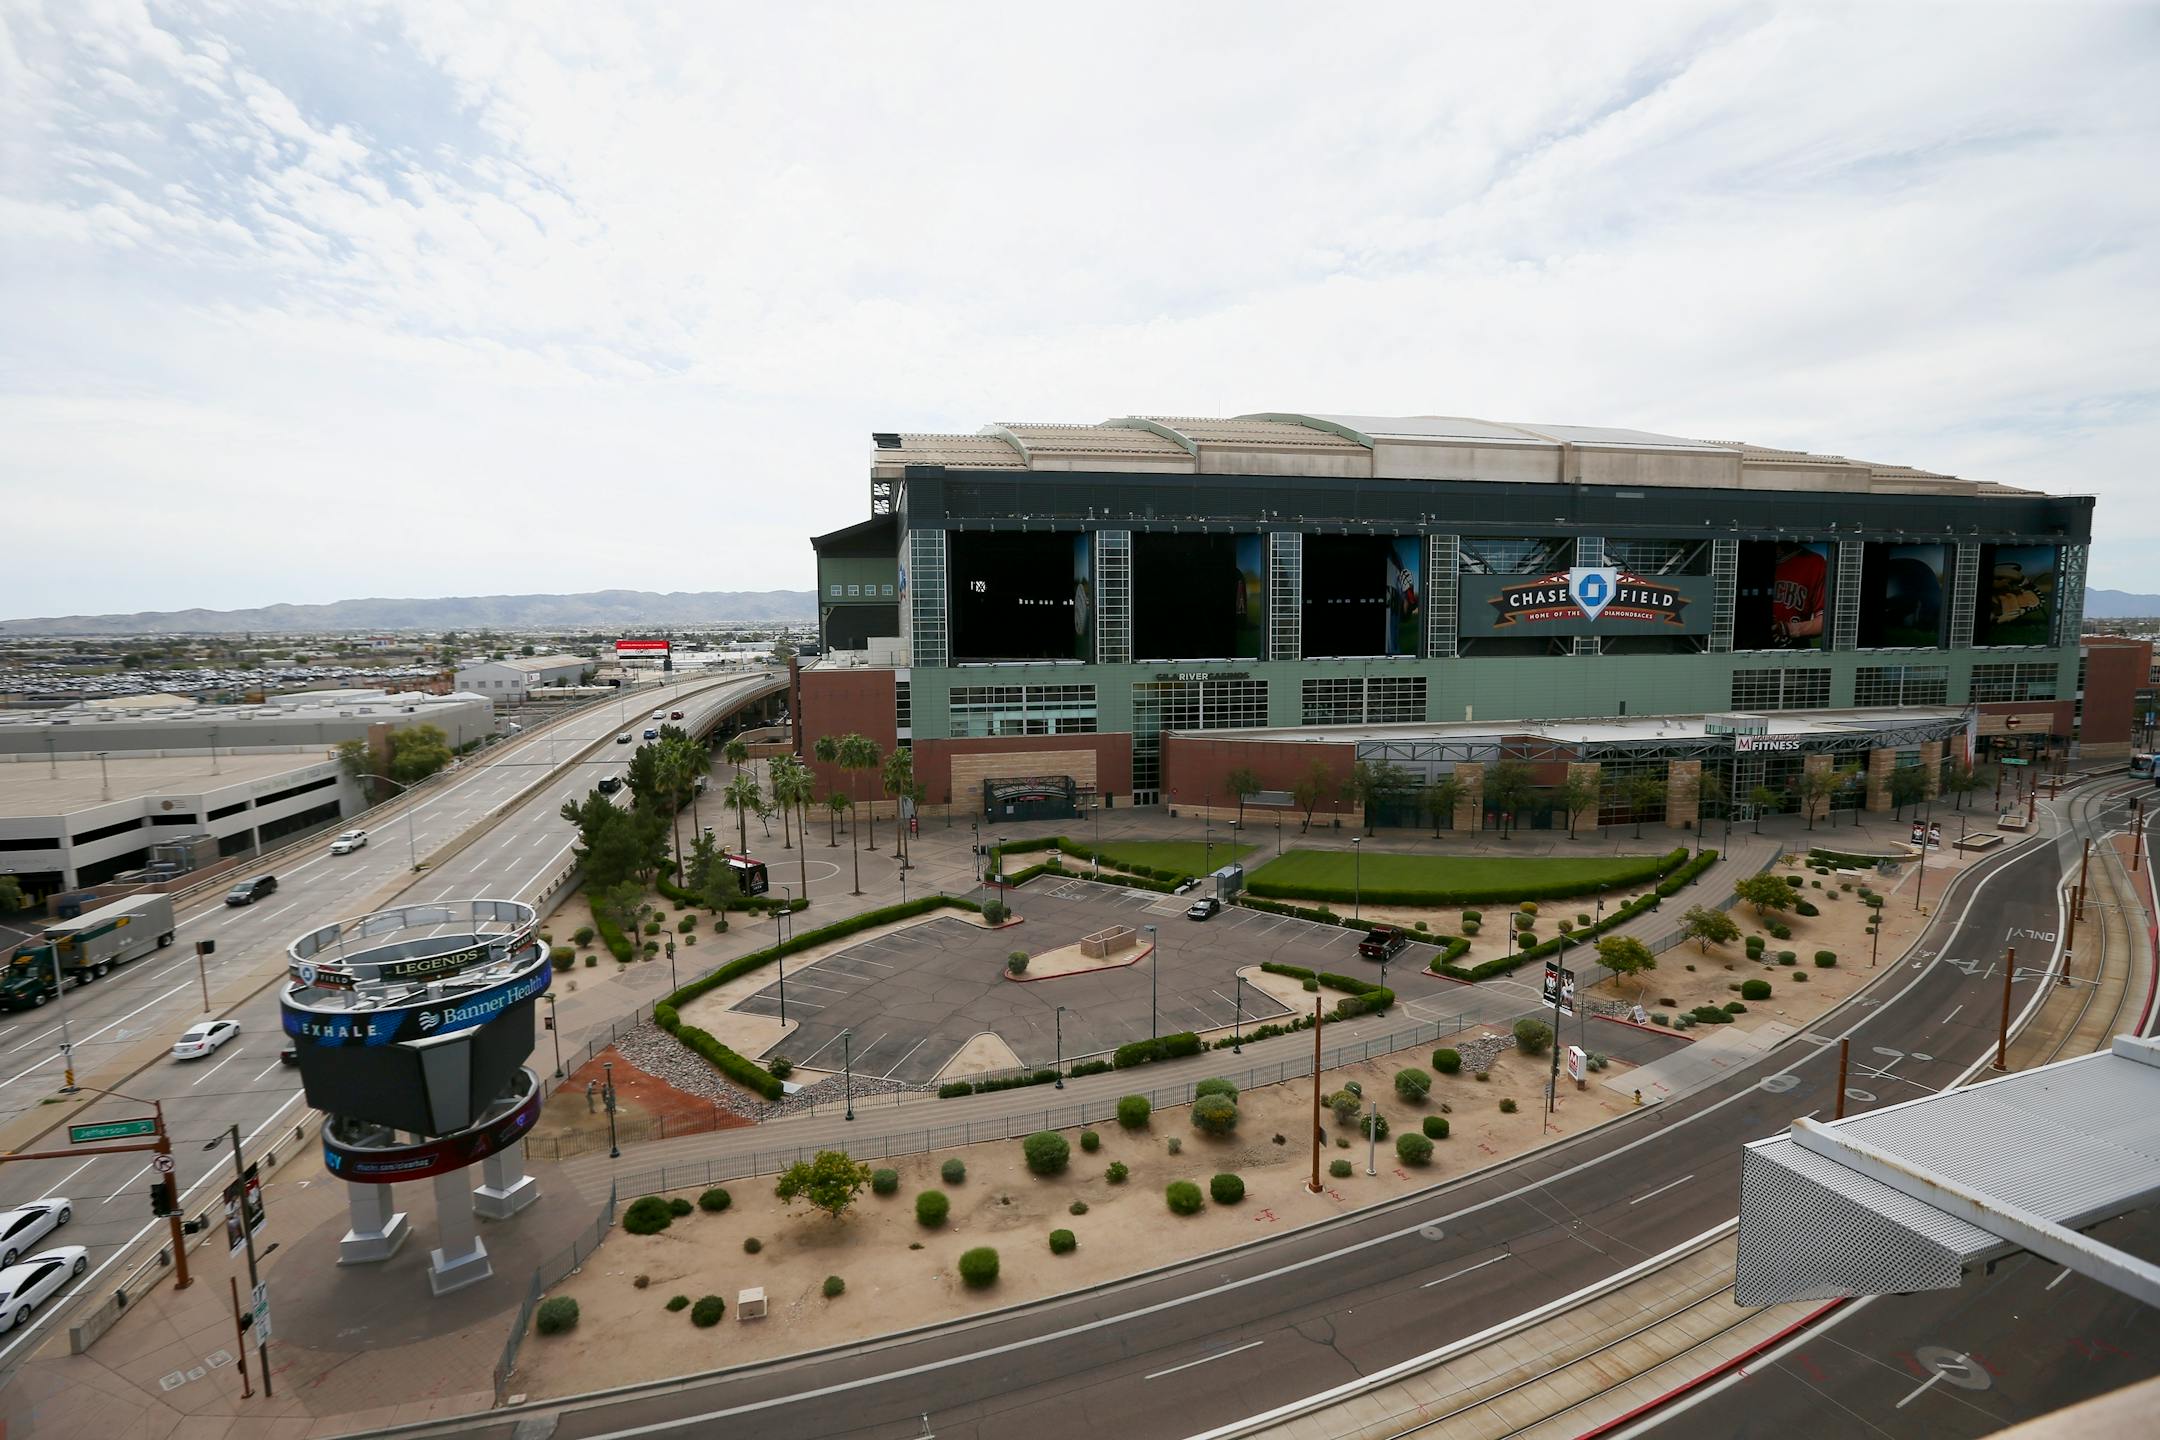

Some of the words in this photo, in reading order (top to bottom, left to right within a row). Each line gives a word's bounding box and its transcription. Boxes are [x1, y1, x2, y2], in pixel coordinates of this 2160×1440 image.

[1509, 589, 1567, 607] CHASE
[1620, 590, 1674, 607] FIELD
[1604, 610, 1653, 619] DIAMONDBACKS
[1179, 672, 1209, 681] RIVER
[1738, 737, 1750, 750] M
[1752, 740, 1800, 751] FITNESS
[2013, 928, 2056, 942] ONLY
[394, 949, 478, 975] LEGENDS
[320, 974, 349, 984] FIELD
[443, 994, 506, 1026] Banner
[506, 974, 544, 1005] Health
[302, 1023, 377, 1037] EXHALE
